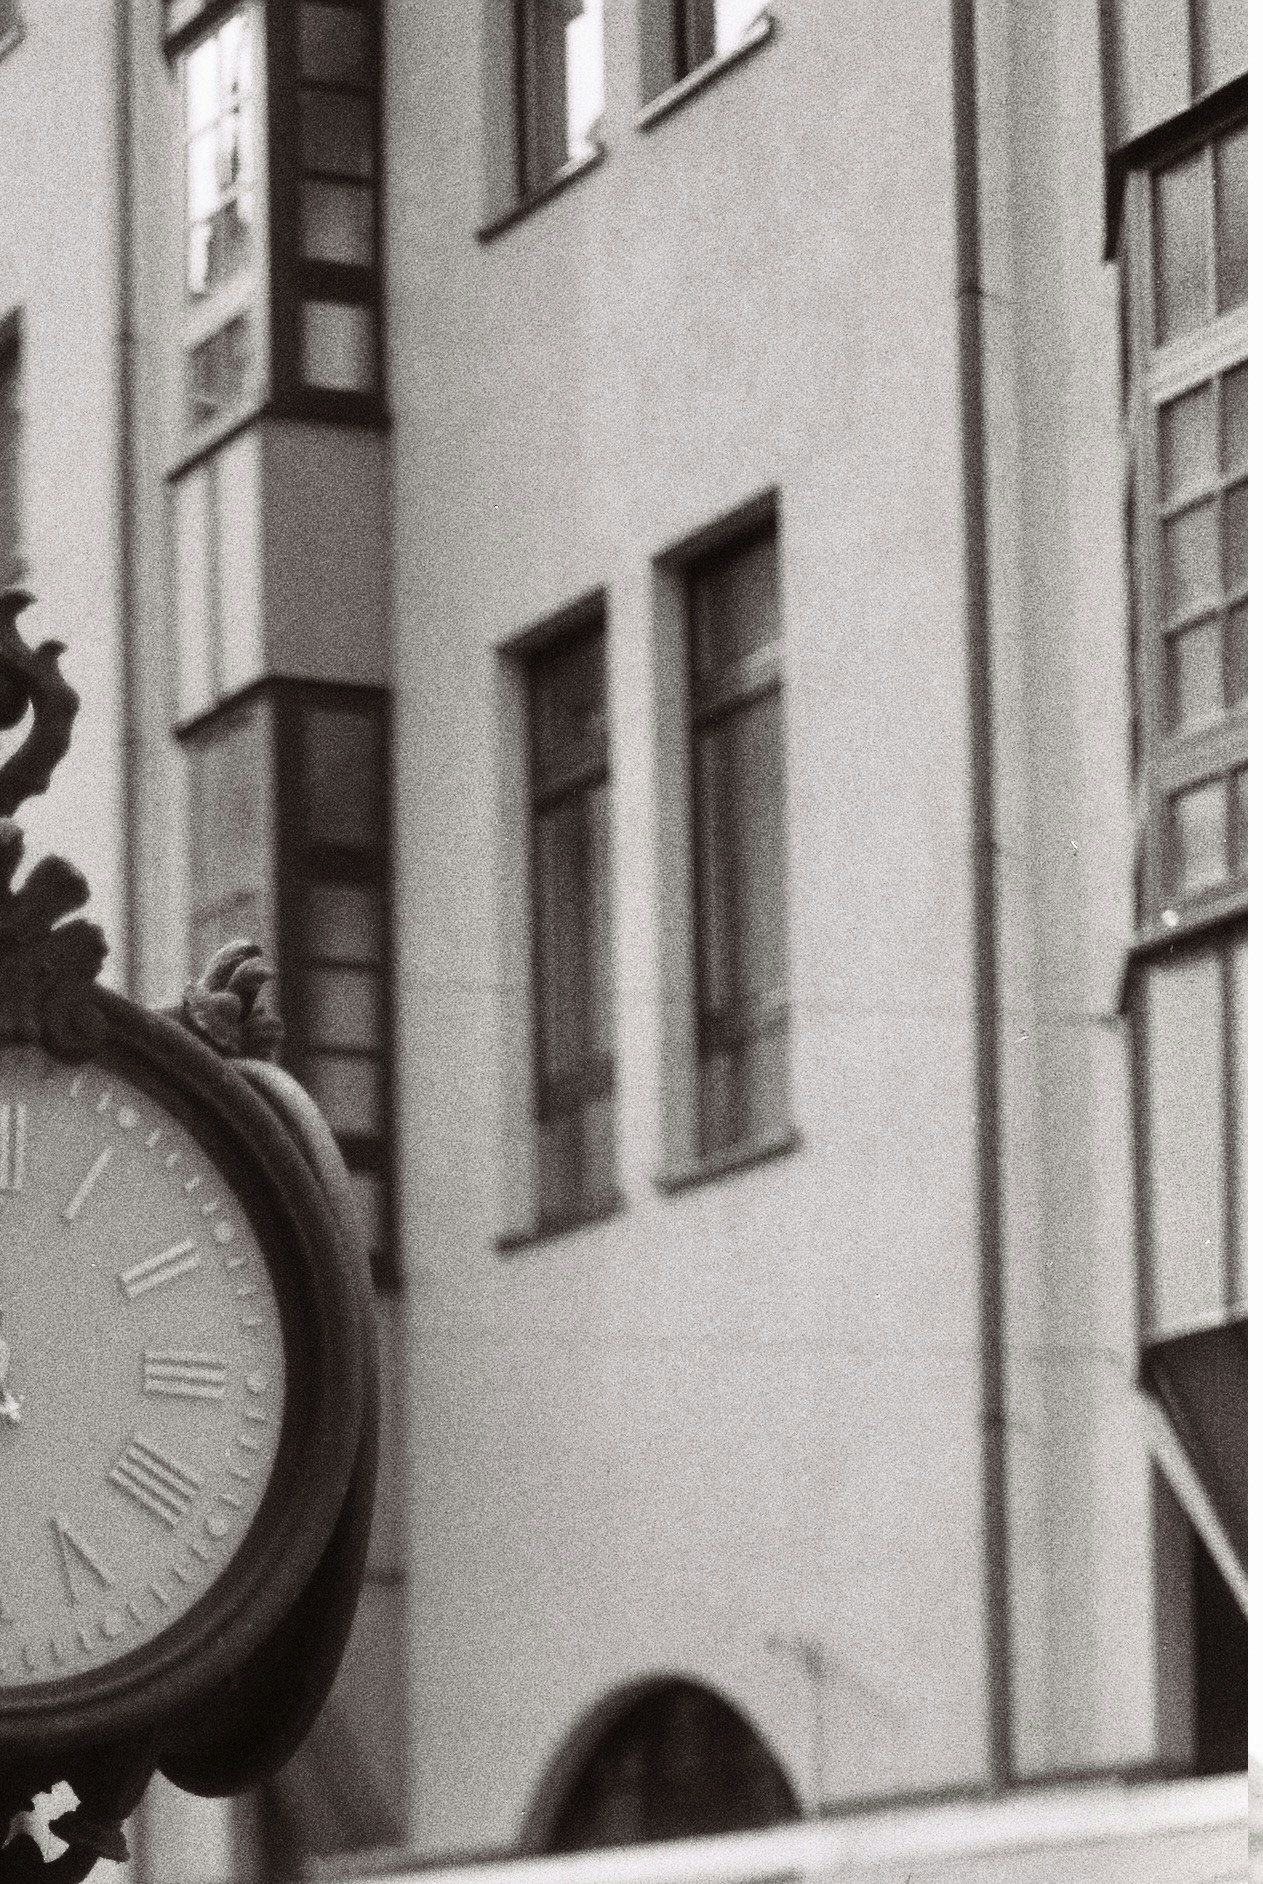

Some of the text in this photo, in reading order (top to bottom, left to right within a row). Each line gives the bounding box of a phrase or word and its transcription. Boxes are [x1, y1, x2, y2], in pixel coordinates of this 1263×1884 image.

[64, 1144, 115, 1222] I
[117, 1239, 202, 1301] II
[142, 1348, 228, 1401] III
[107, 1440, 202, 1533] IIII
[48, 1514, 118, 1610] V
